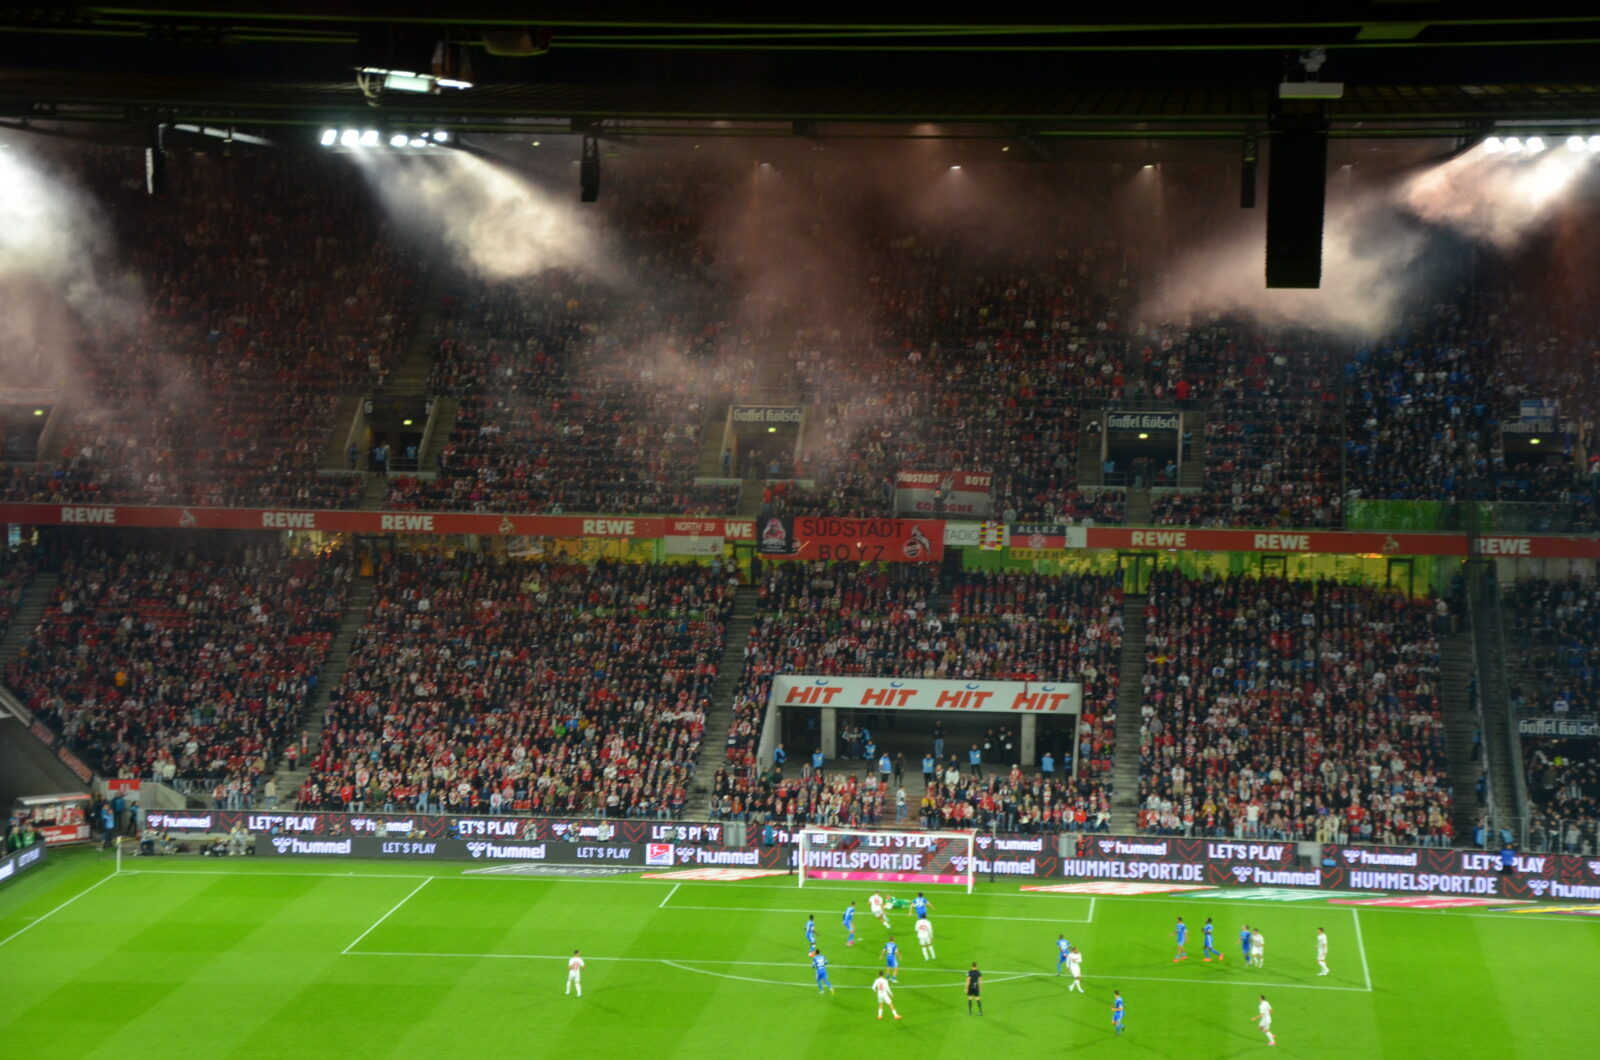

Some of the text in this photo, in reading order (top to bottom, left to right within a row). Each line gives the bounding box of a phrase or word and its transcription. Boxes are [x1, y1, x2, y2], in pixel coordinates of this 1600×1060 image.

[1108, 414, 1179, 430] Gaffel Kölsch
[964, 475, 992, 487] BOYZ
[61, 507, 117, 524] REWE
[262, 512, 316, 529] REWE
[381, 514, 435, 531] REWE
[583, 519, 636, 536] REWE
[674, 521, 702, 532] NORTH
[724, 522, 753, 538] WE
[1017, 525, 1059, 534] ALLEZ
[1132, 530, 1187, 547] REWE
[1255, 533, 1310, 550] REWE
[1474, 538, 1532, 555] REWE
[819, 544, 885, 562] BOYZ
[785, 686, 843, 705] HIT
[860, 688, 918, 707] HIT
[935, 690, 993, 709] HIT
[1011, 692, 1070, 711] HIT
[1519, 720, 1557, 735] Gaffel
[163, 814, 211, 828] hummel
[285, 816, 317, 831] PLAY
[366, 819, 414, 832] hmmel
[458, 820, 518, 836] ET'S PLAY
[292, 837, 352, 854] hummel
[382, 842, 437, 854] LET'S PLAY
[486, 842, 545, 859] hummel
[577, 846, 631, 859] LET'S PLAY
[994, 838, 1043, 852] hummel
[1115, 840, 1168, 856] hummel
[1208, 843, 1285, 861] LET'S PLAY
[697, 847, 760, 865] hummel
[1360, 850, 1417, 867] hummel
[1462, 854, 1504, 871] LET'S
[971, 855, 1036, 875] hummel
[1063, 859, 1204, 882] HUMMELSPORT.DE
[1254, 867, 1321, 886] hummel
[1349, 870, 1498, 895] HUMMELSPORT.DE
